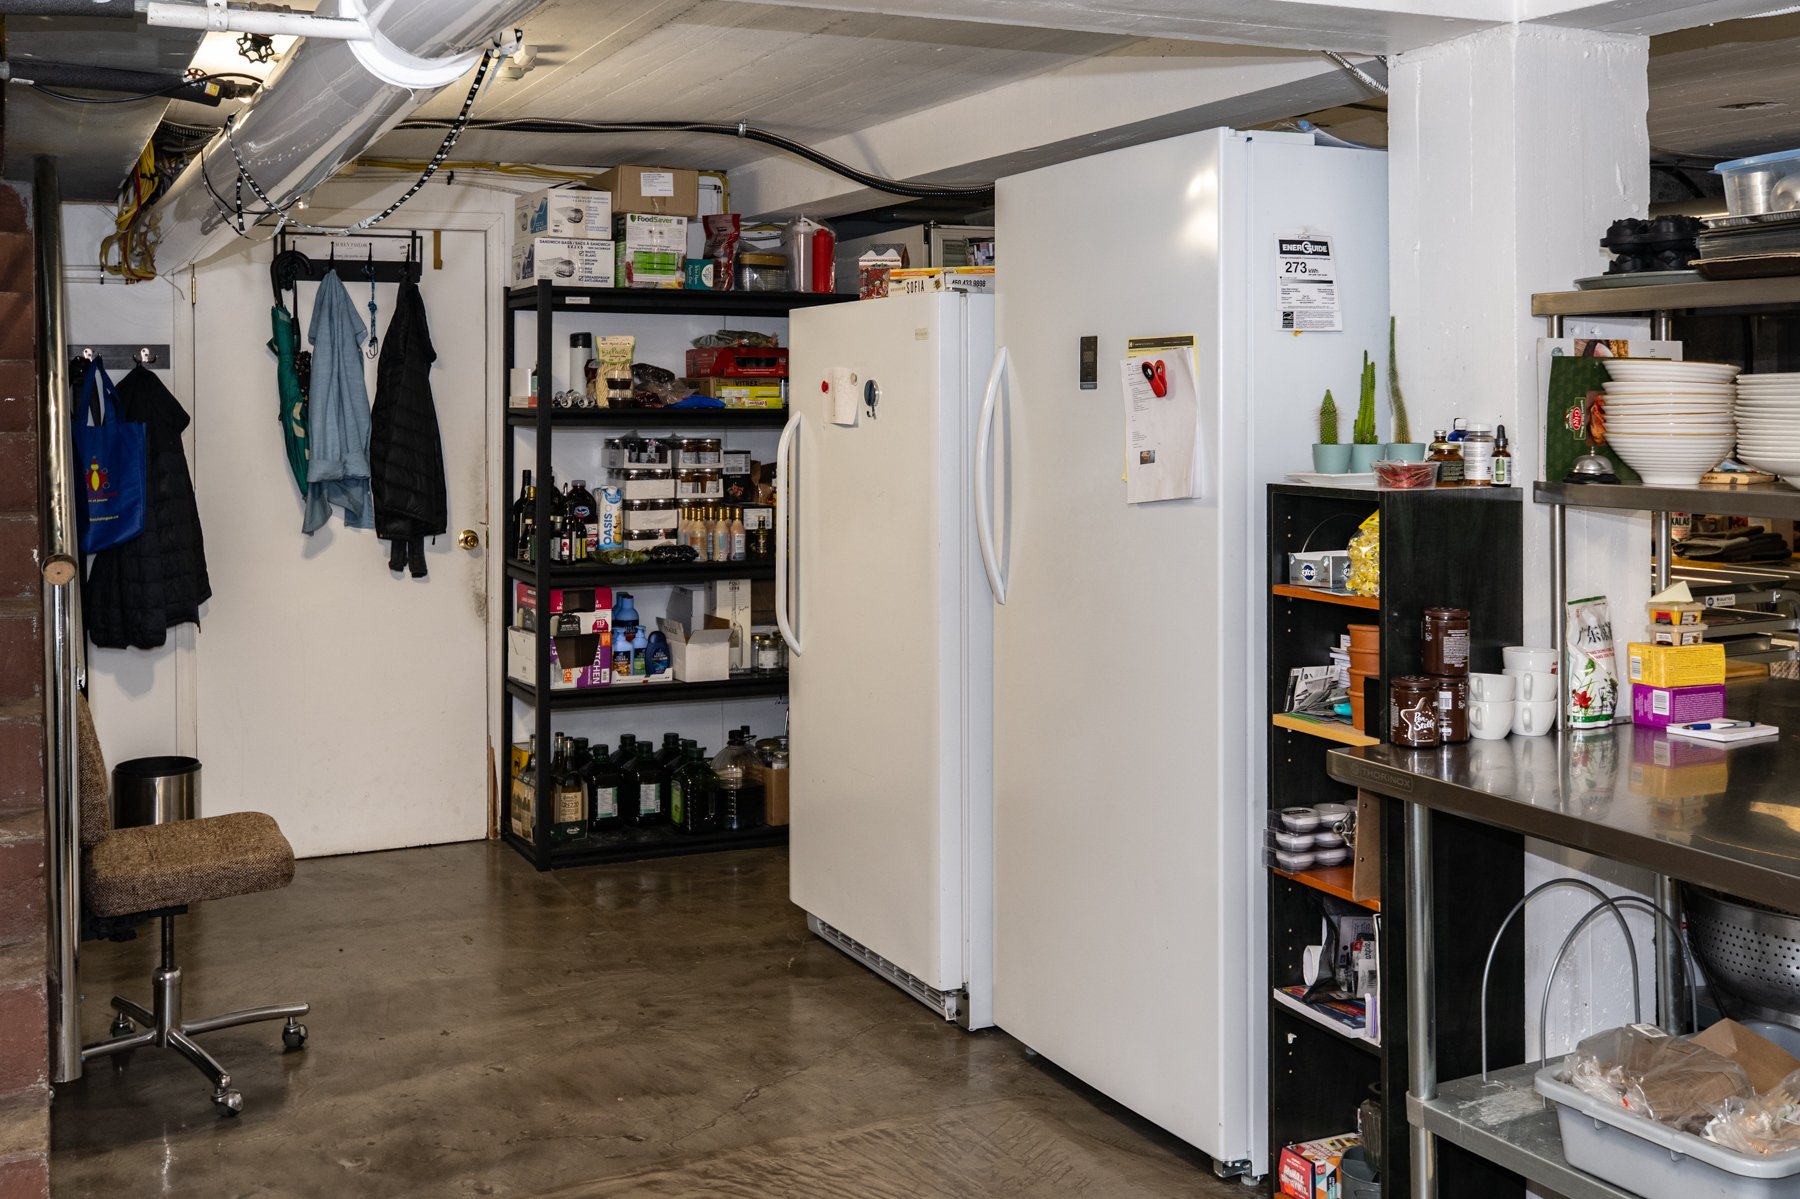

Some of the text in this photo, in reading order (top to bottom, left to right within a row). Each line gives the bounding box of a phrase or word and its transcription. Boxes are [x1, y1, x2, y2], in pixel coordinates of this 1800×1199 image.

[637, 216, 673, 224] FoodSaver
[1285, 261, 1307, 274] 273
[603, 513, 613, 546] OASIS
[1362, 767, 1411, 788] THORINOX
